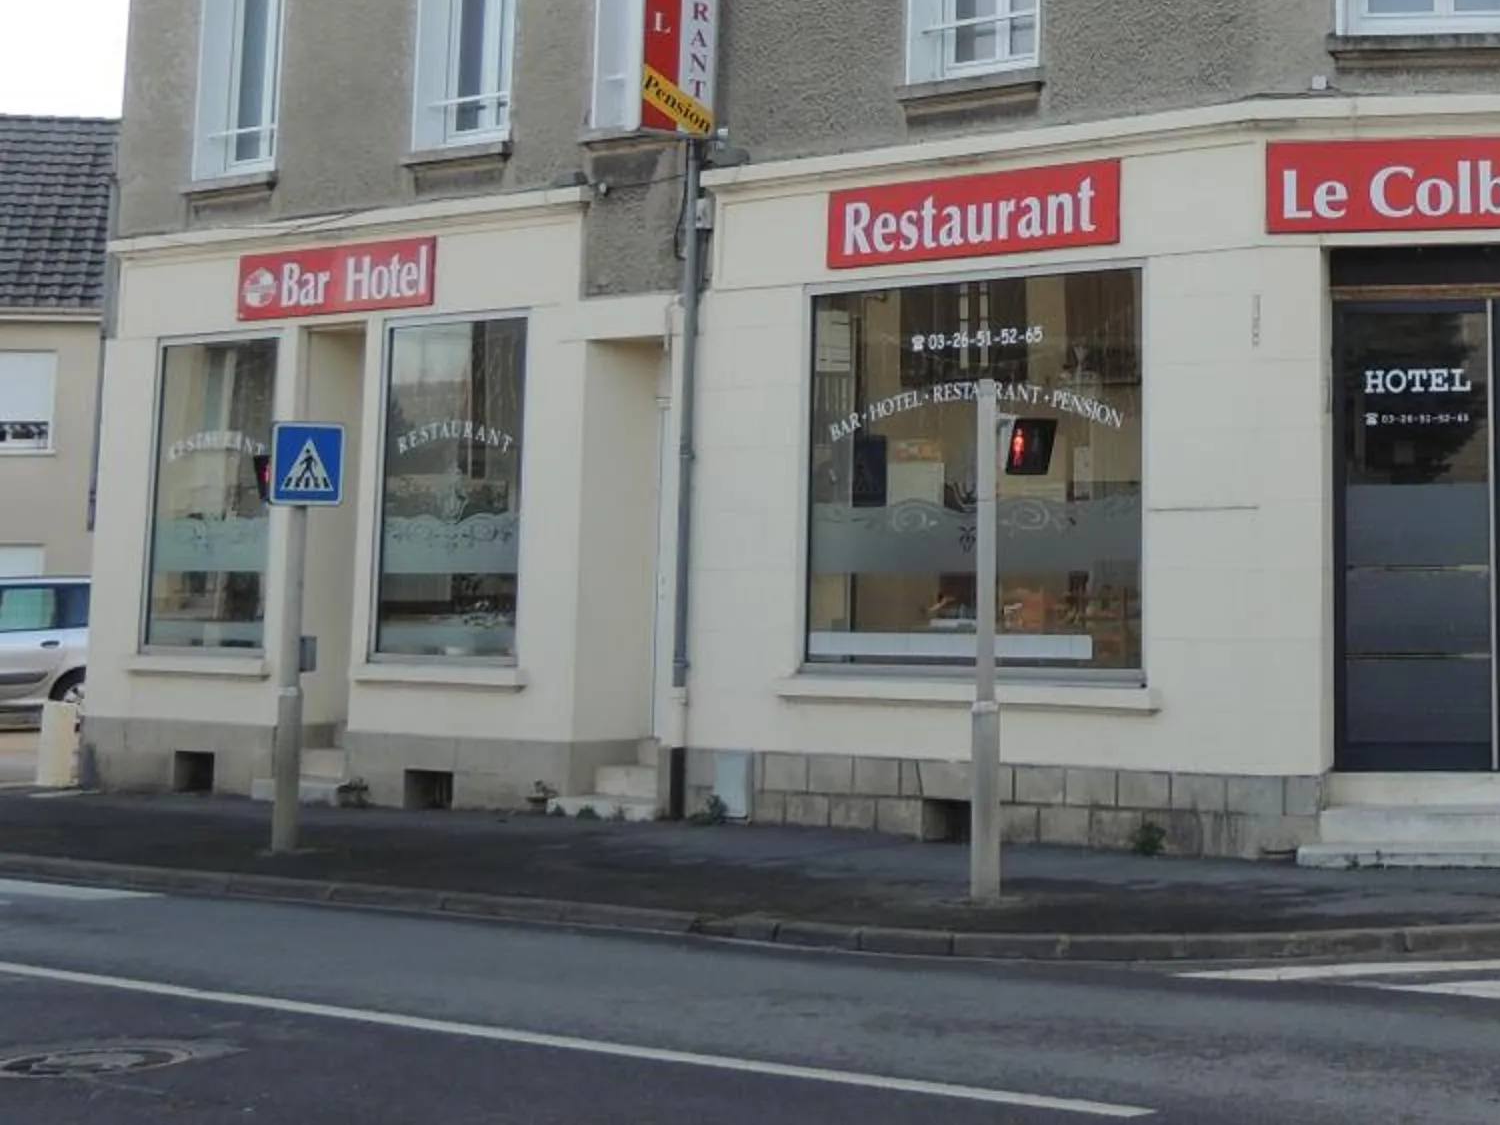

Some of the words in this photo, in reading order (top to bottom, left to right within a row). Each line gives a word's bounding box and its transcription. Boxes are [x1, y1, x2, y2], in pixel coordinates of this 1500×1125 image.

[643, 74, 712, 133] Pension
[842, 175, 1097, 256] Restaurant
[1282, 169, 1349, 220] Le
[280, 261, 330, 308] Bar
[345, 245, 428, 302] Hotel
[927, 325, 1043, 351] 03-26-51-52-65
[1364, 368, 1472, 394] HOTEL
[396, 418, 514, 455] RESTAURANT
[829, 412, 861, 442] BAR
[869, 390, 923, 422] HOTEL
[933, 381, 1043, 405] RESTARANT
[1052, 389, 1125, 429] PENSION
